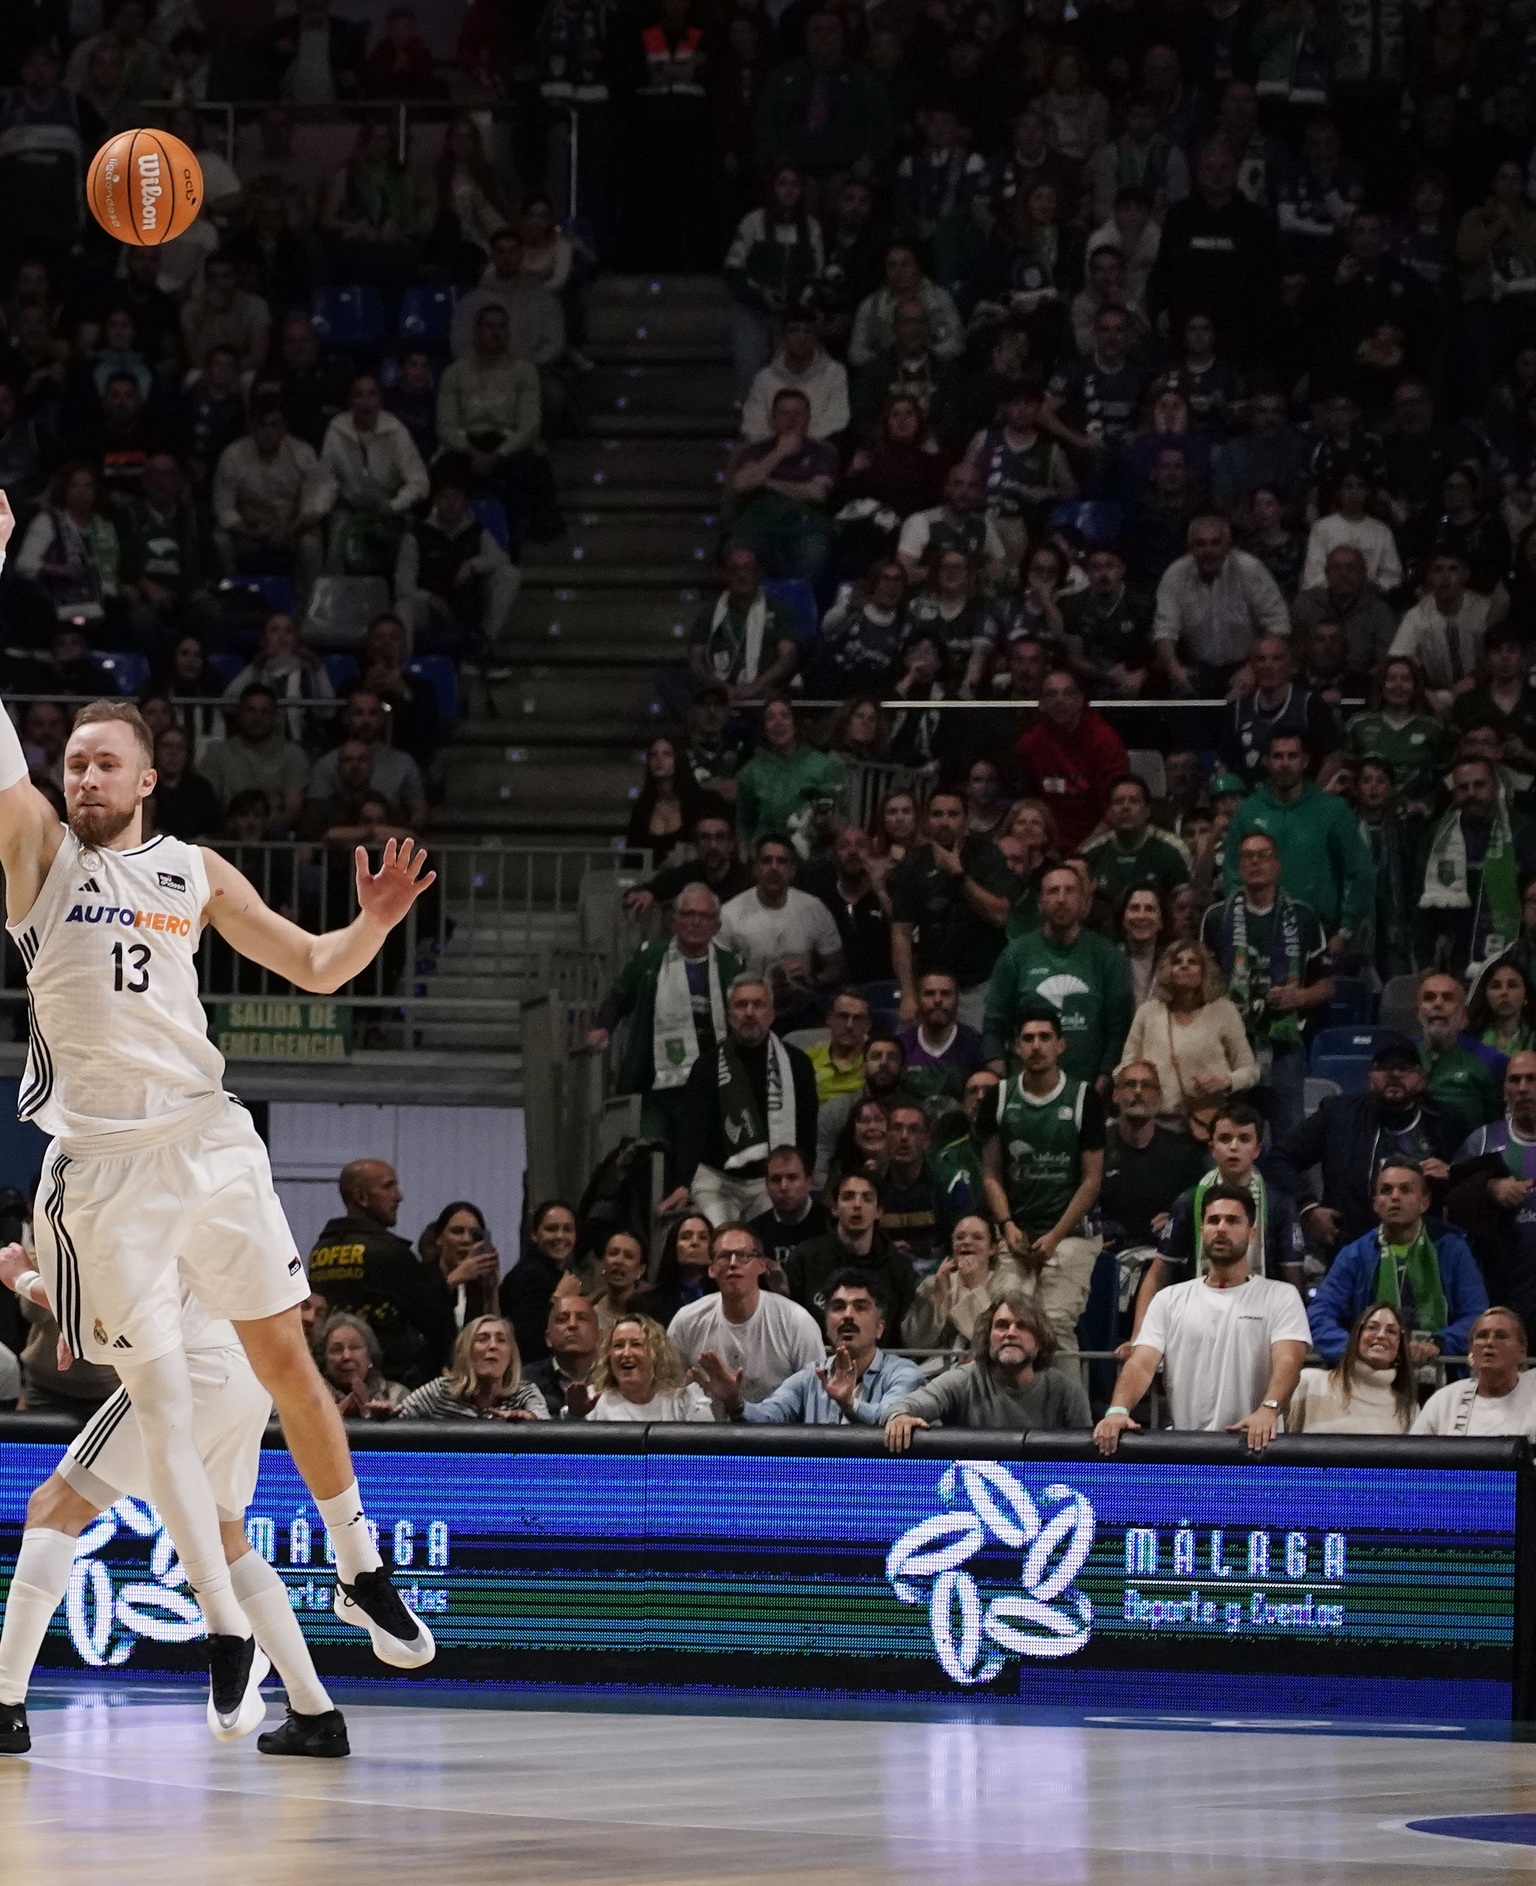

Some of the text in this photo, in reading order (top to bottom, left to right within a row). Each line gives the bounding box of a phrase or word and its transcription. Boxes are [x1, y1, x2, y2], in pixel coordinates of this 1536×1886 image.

[137, 152, 163, 231] Wilson
[65, 904, 191, 937] AUTOHERO
[110, 941, 152, 993] 13
[228, 1002, 336, 1029] SALIDA DE
[218, 1032, 344, 1057] EMERGENCIA
[1125, 1517, 1347, 1580] MÁLAGA
[1123, 1588, 1346, 1635] Deporte y Eventos
